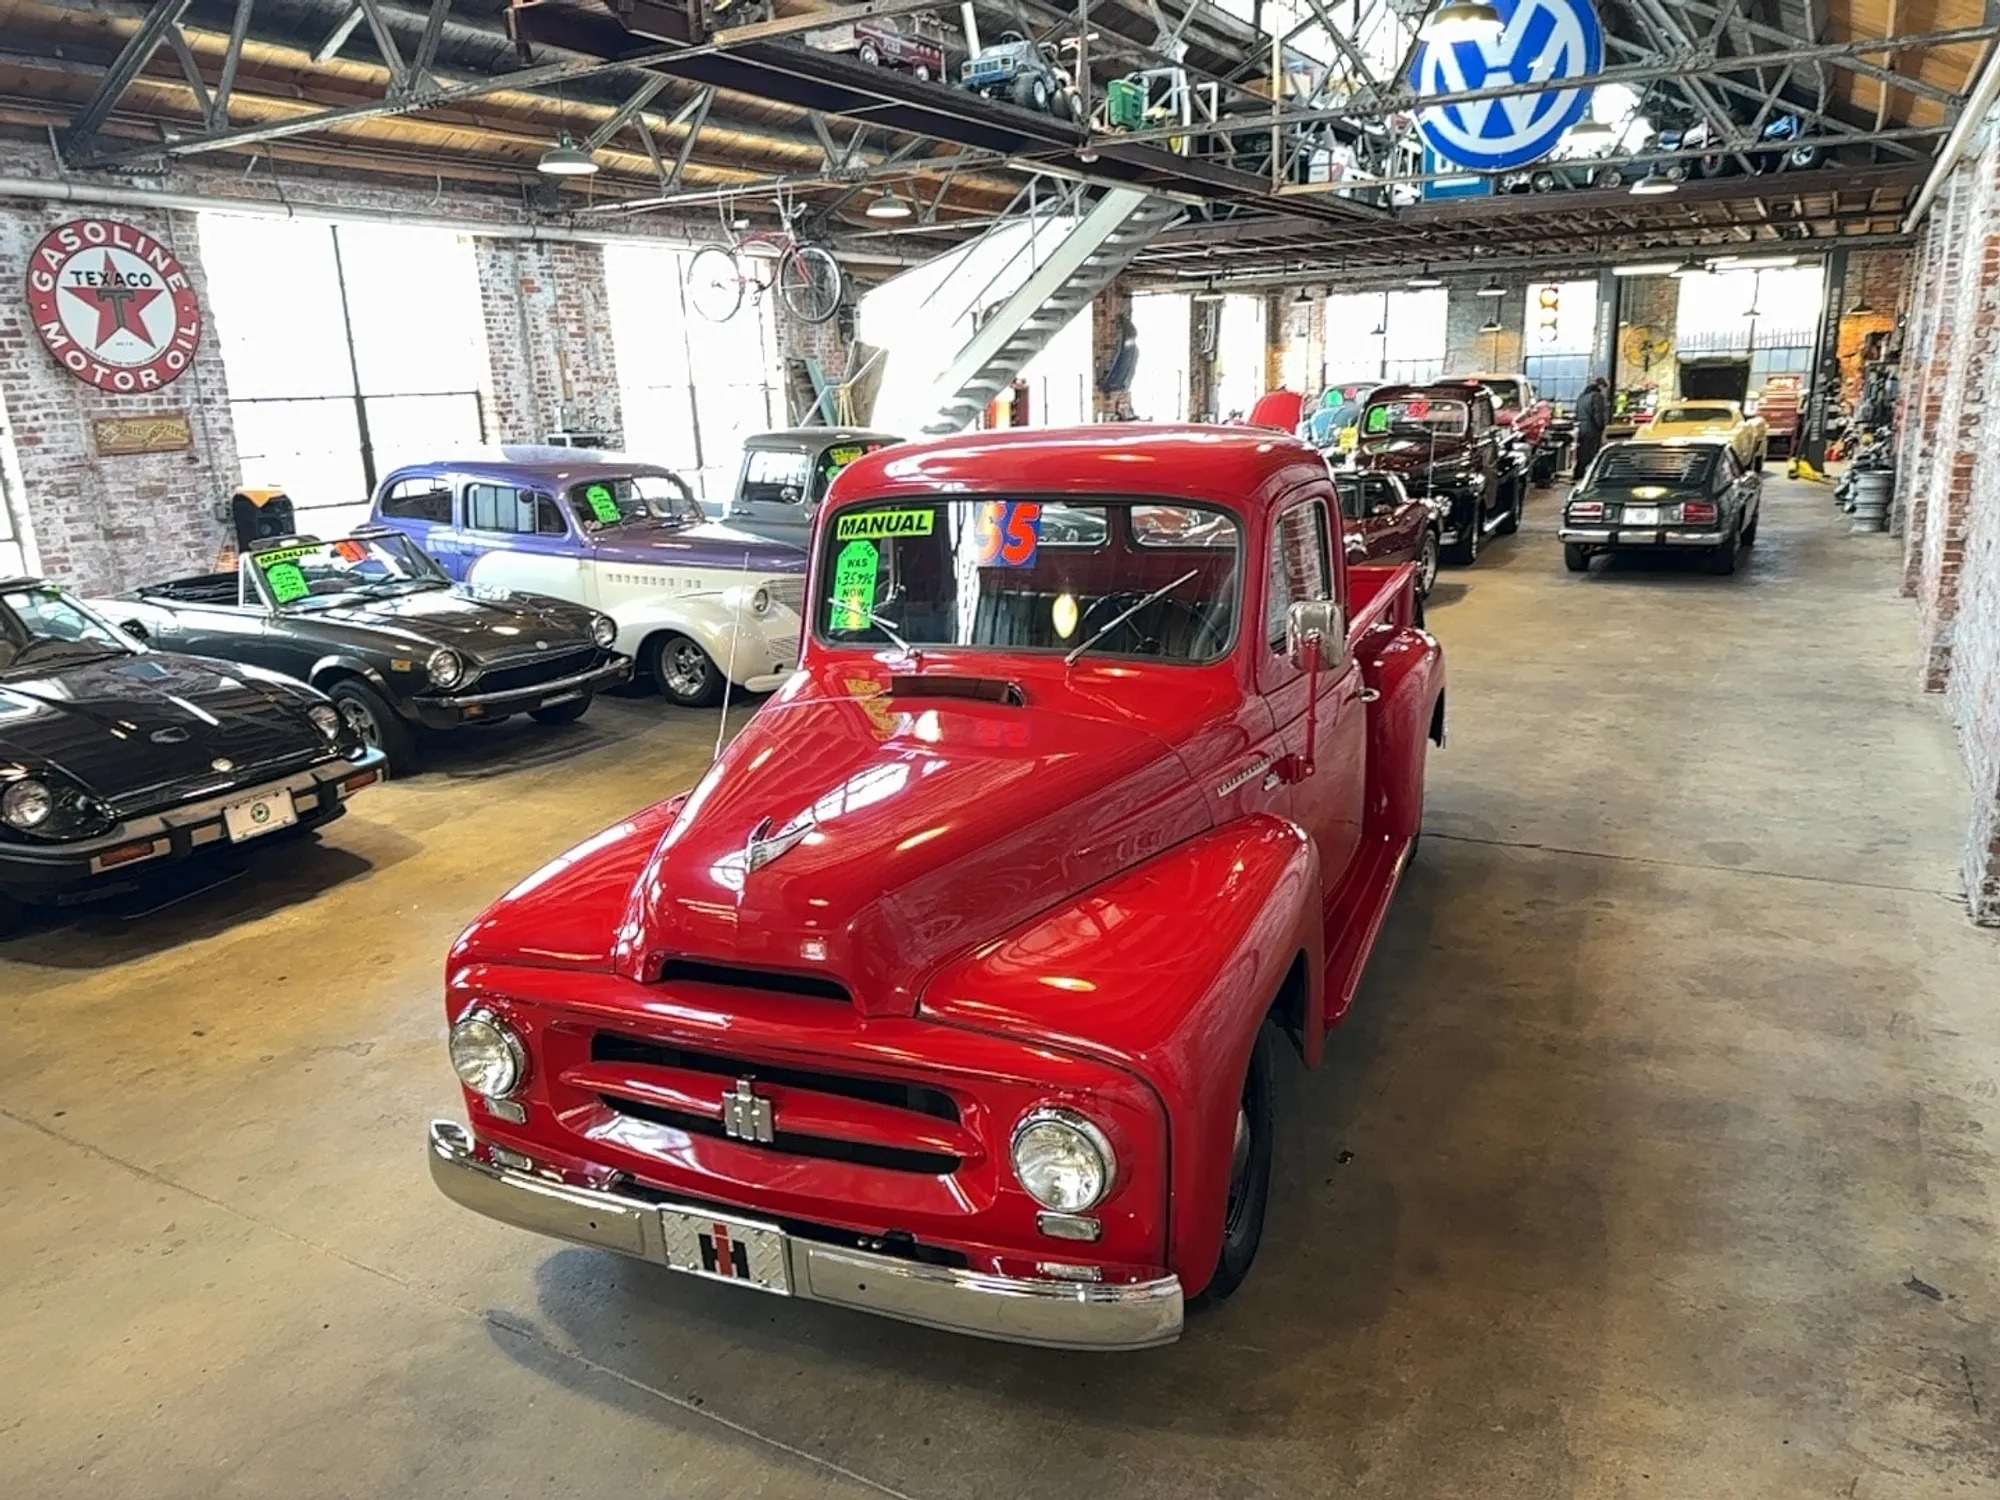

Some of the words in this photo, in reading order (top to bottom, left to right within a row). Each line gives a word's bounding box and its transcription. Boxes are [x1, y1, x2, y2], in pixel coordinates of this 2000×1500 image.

[31, 221, 189, 293] GASOLINE
[70, 270, 153, 288] TEXACO
[41, 320, 161, 390] MOTOR
[166, 321, 196, 370] OIL
[840, 514, 928, 536] MANUAL
[260, 548, 321, 565] MANUAL
[847, 558, 868, 569] WAS
